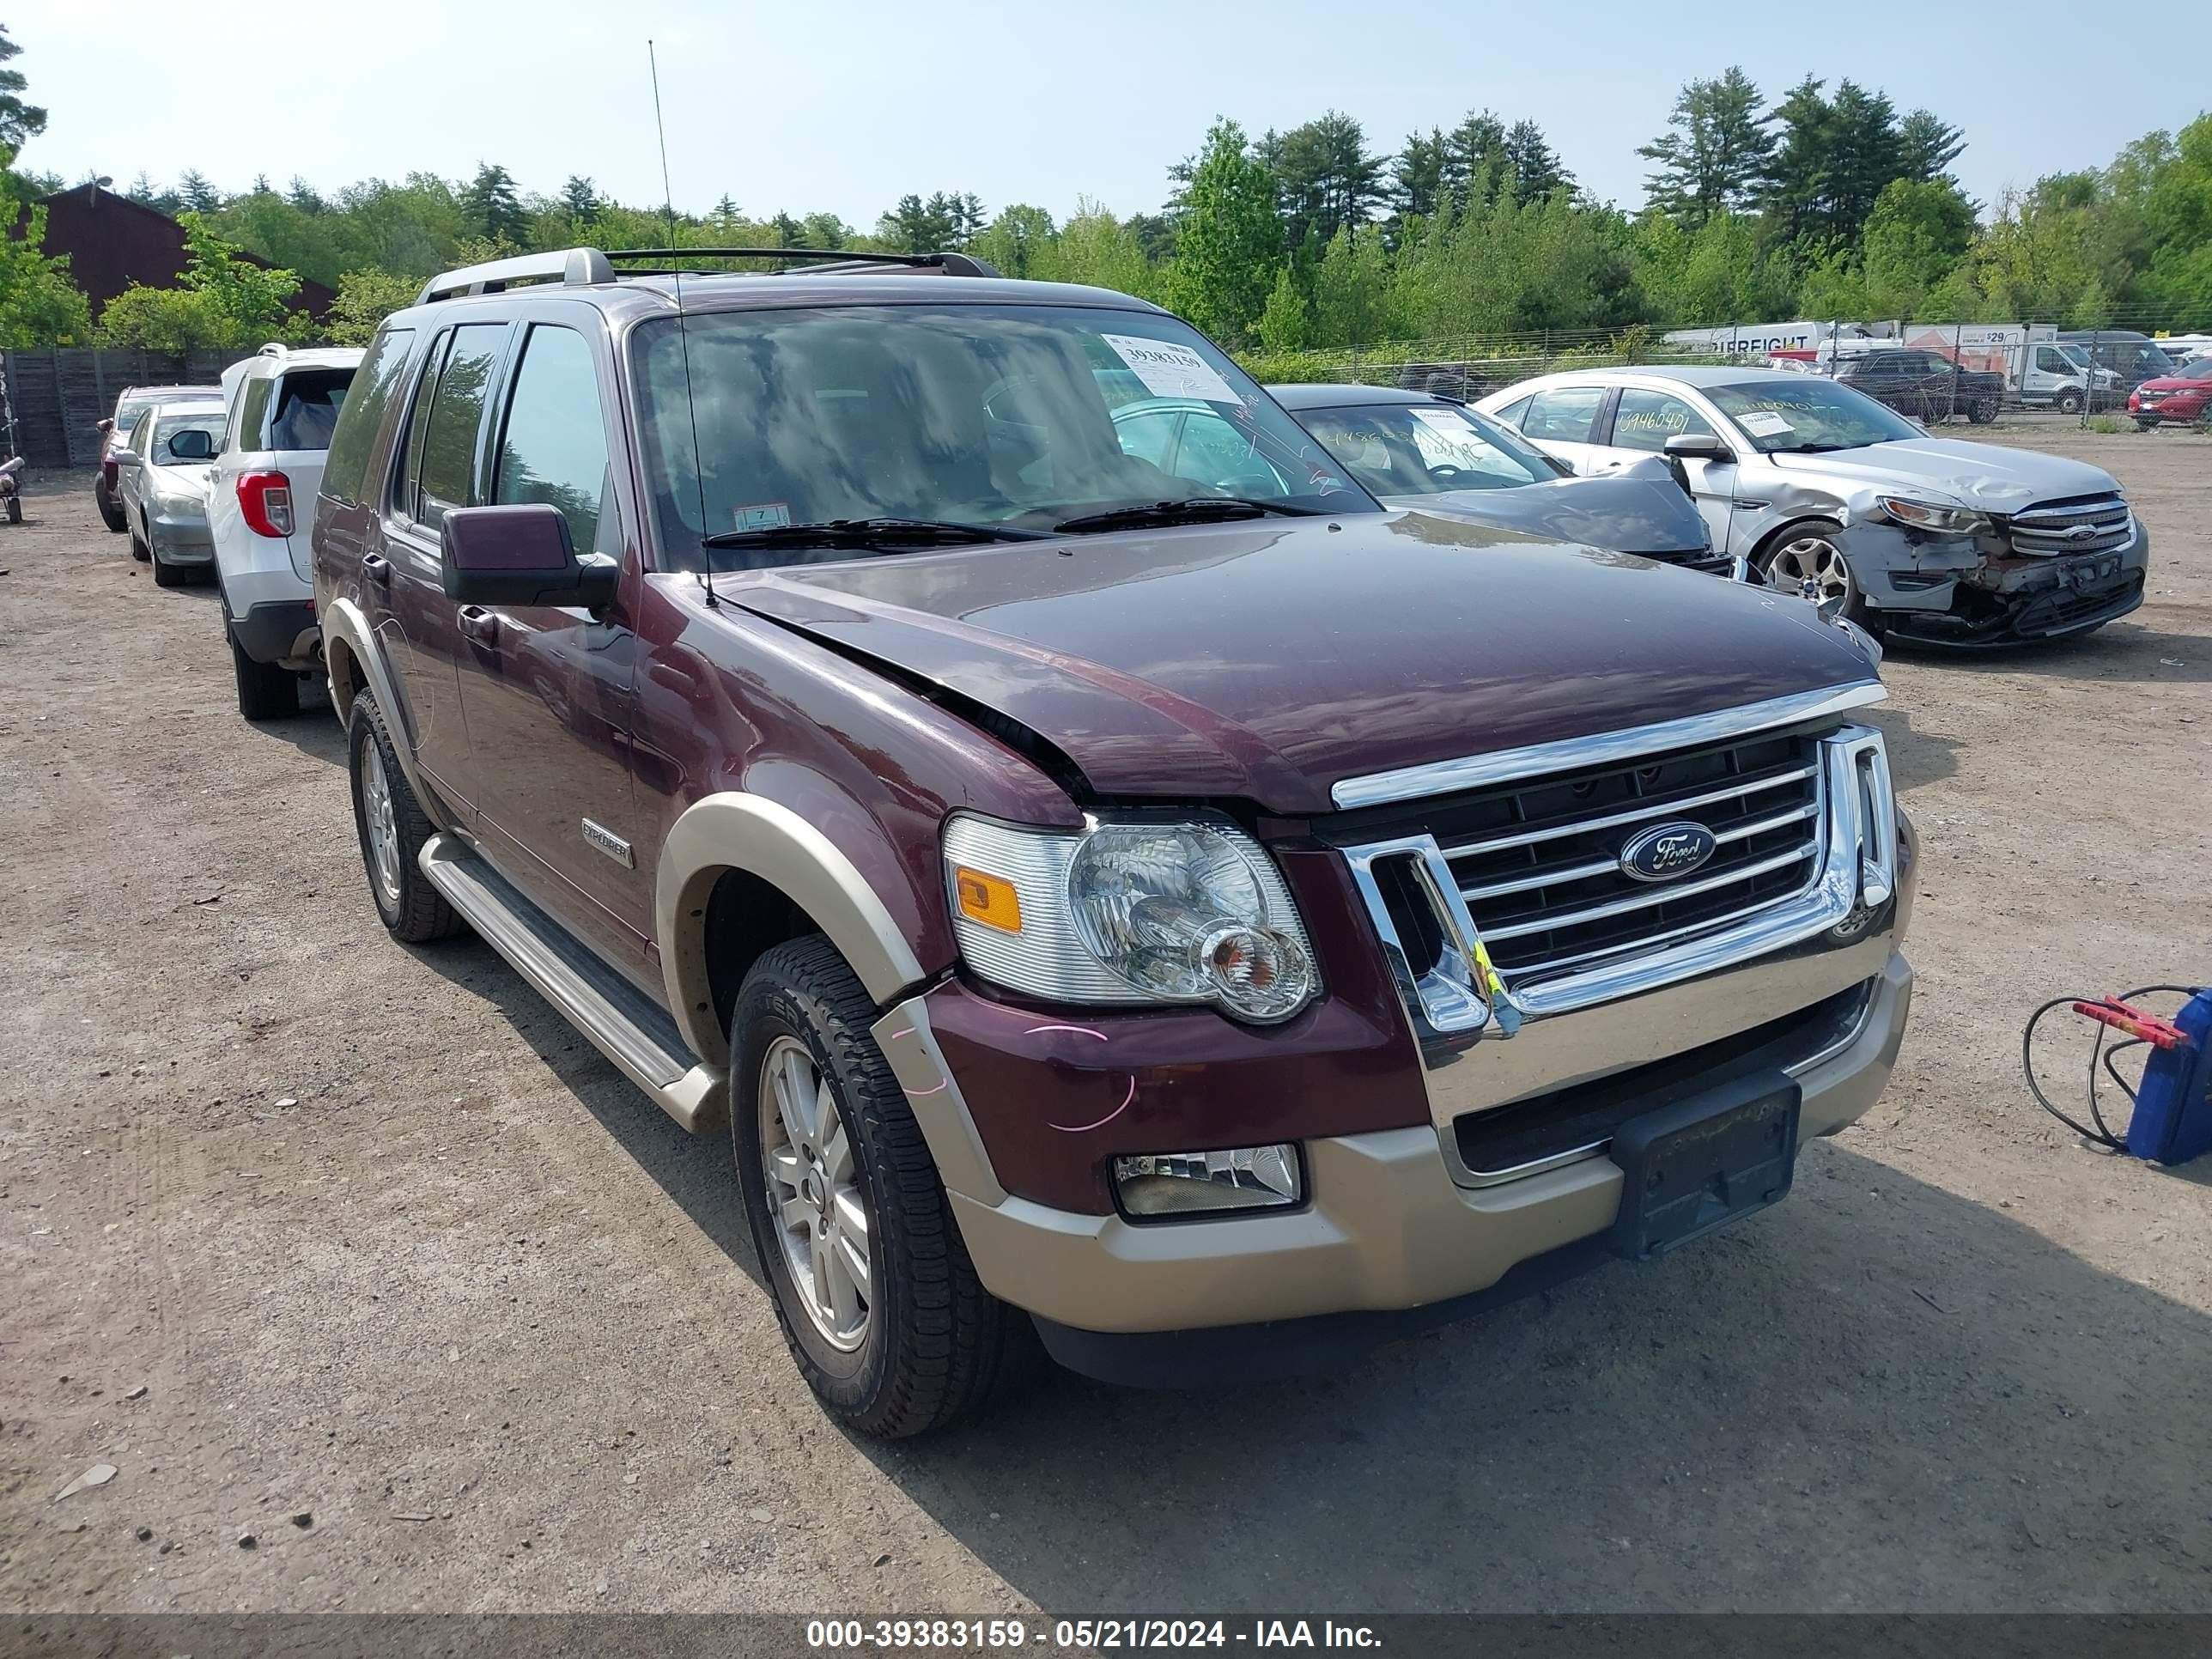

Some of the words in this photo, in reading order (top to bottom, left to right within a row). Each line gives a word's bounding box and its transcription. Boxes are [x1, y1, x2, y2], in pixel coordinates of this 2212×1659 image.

[1987, 331, 2004, 343] $29
[1126, 348, 1201, 368] 39383159
[757, 510, 765, 520] 7
[583, 823, 627, 860] EXPLORER
[1652, 833, 1701, 870] Ford
